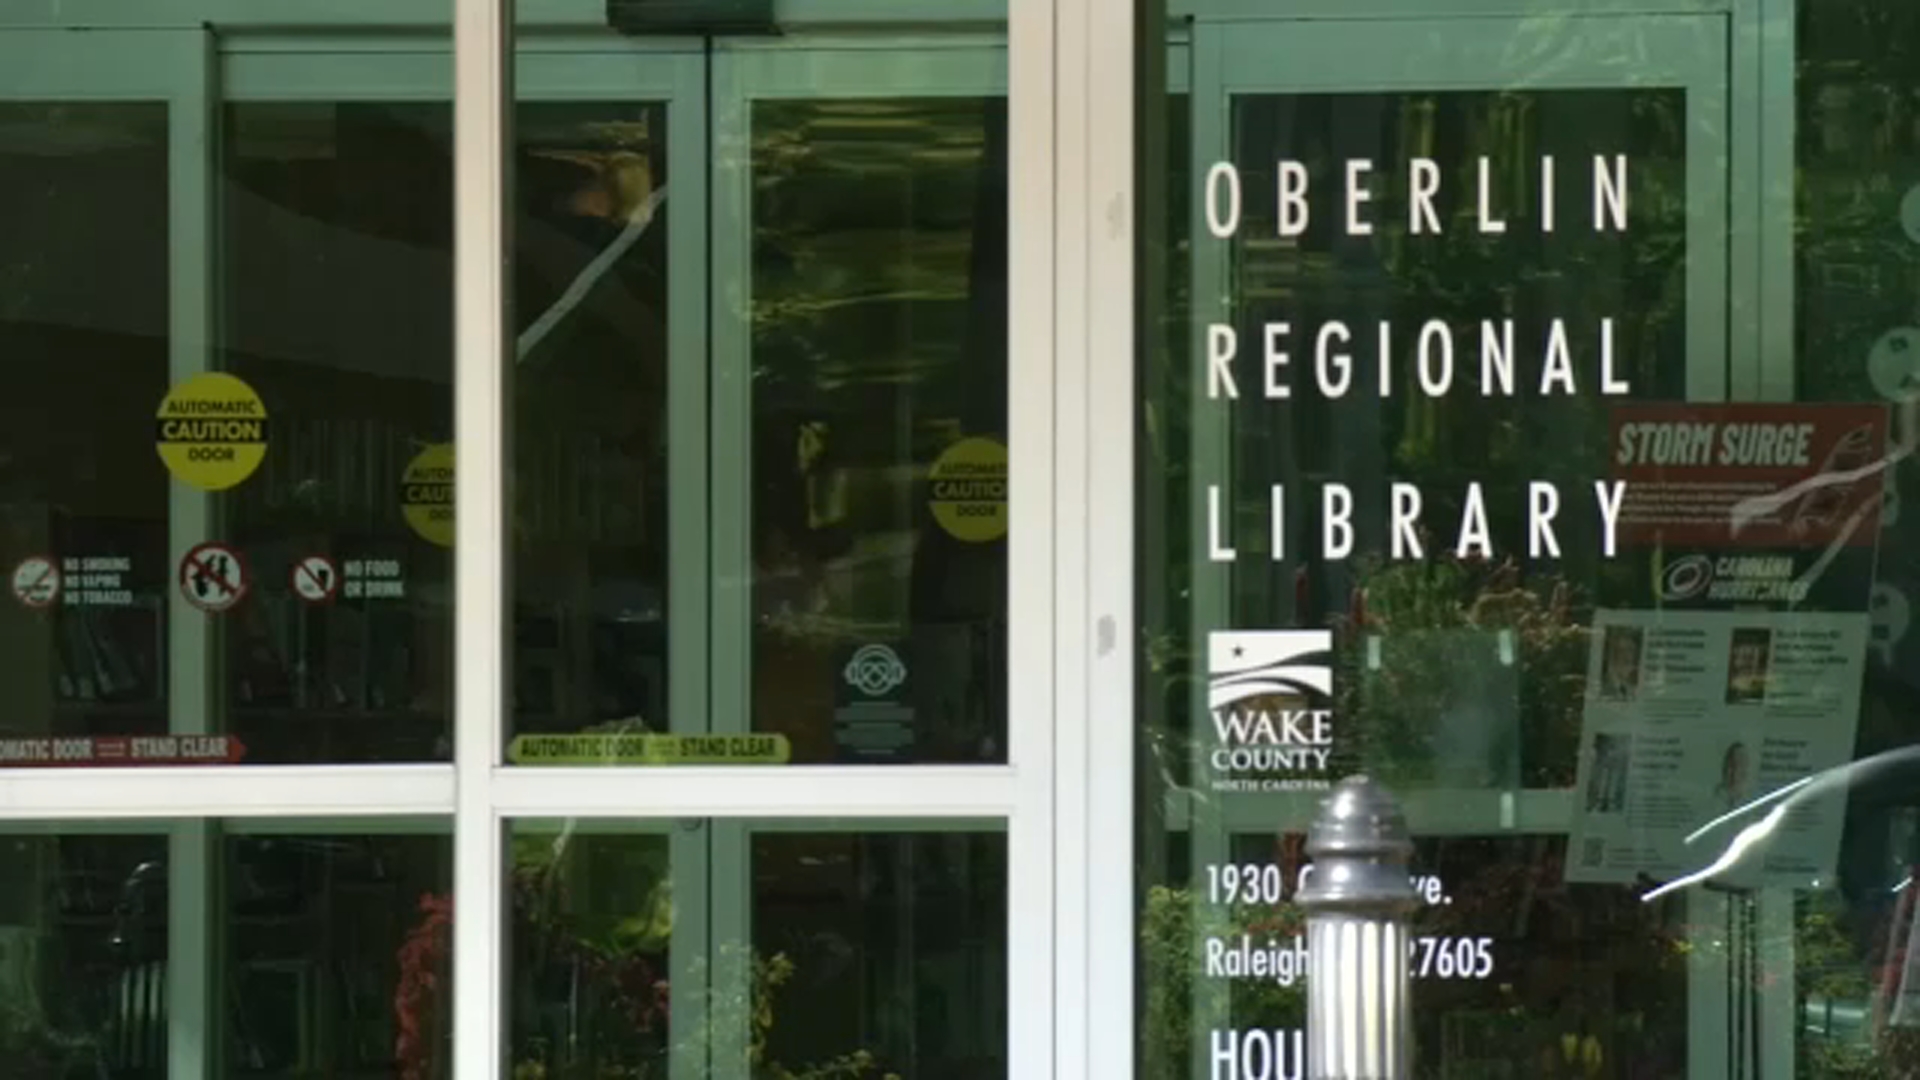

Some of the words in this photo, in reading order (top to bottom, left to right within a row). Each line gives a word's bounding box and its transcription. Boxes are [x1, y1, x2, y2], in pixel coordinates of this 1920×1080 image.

[1205, 154, 1628, 238] OBERLIN
[1207, 317, 1630, 398] REGIONAL
[167, 400, 257, 414] AUTOMATIC
[162, 420, 261, 441] CAUTION
[188, 448, 235, 462] DOOR
[1617, 422, 1714, 465] STORM
[1719, 423, 1814, 467] SURGE
[1208, 480, 1627, 561] LIBRARY
[64, 557, 80, 571] NO
[344, 561, 362, 576] NO
[365, 561, 399, 576] FOOD
[64, 574, 80, 588] NO
[344, 581, 362, 596] OR
[64, 591, 80, 604] NO
[1211, 709, 1333, 744] WAKE
[53, 738, 93, 758] DOOR
[131, 737, 177, 758] STAND
[181, 737, 228, 757] CLEAR
[520, 738, 601, 757] AUTOMATIC
[679, 738, 726, 757] STAND
[731, 738, 776, 757] CLEAR
[1211, 748, 1331, 770] COUNTY
[1206, 864, 1281, 904] 1930
